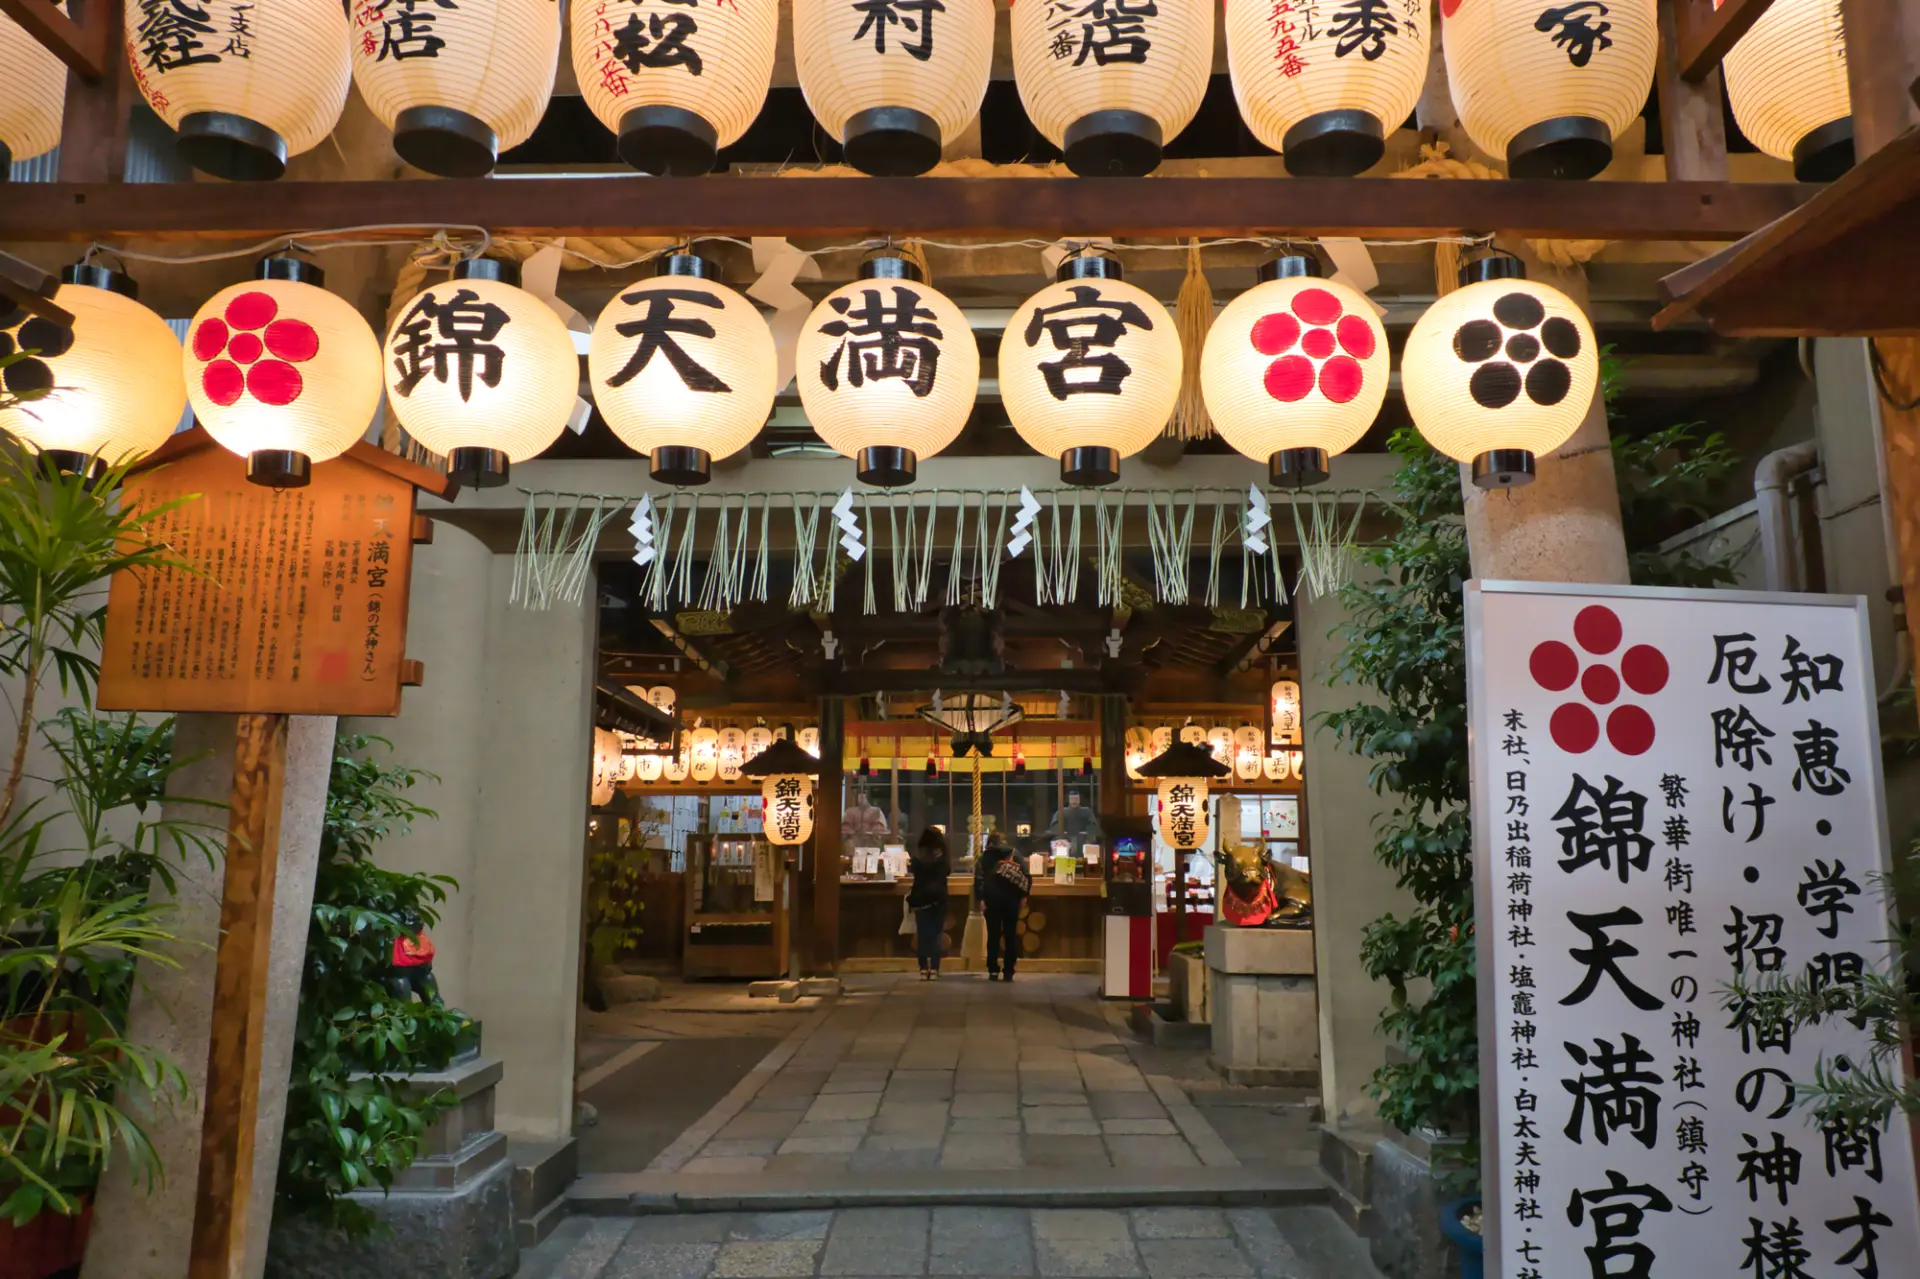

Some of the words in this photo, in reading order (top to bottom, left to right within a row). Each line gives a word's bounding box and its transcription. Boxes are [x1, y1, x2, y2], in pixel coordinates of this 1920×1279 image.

[375, 0, 460, 63] 店
[612, 0, 703, 76] 松
[1326, 0, 1398, 61] 秀
[361, 493, 395, 682] 天満宮（錦の天神さん）
[775, 777, 802, 841] 錦天満宮
[1169, 784, 1196, 846] 錦天満宮
[1551, 772, 1674, 1279] 錦天満宮
